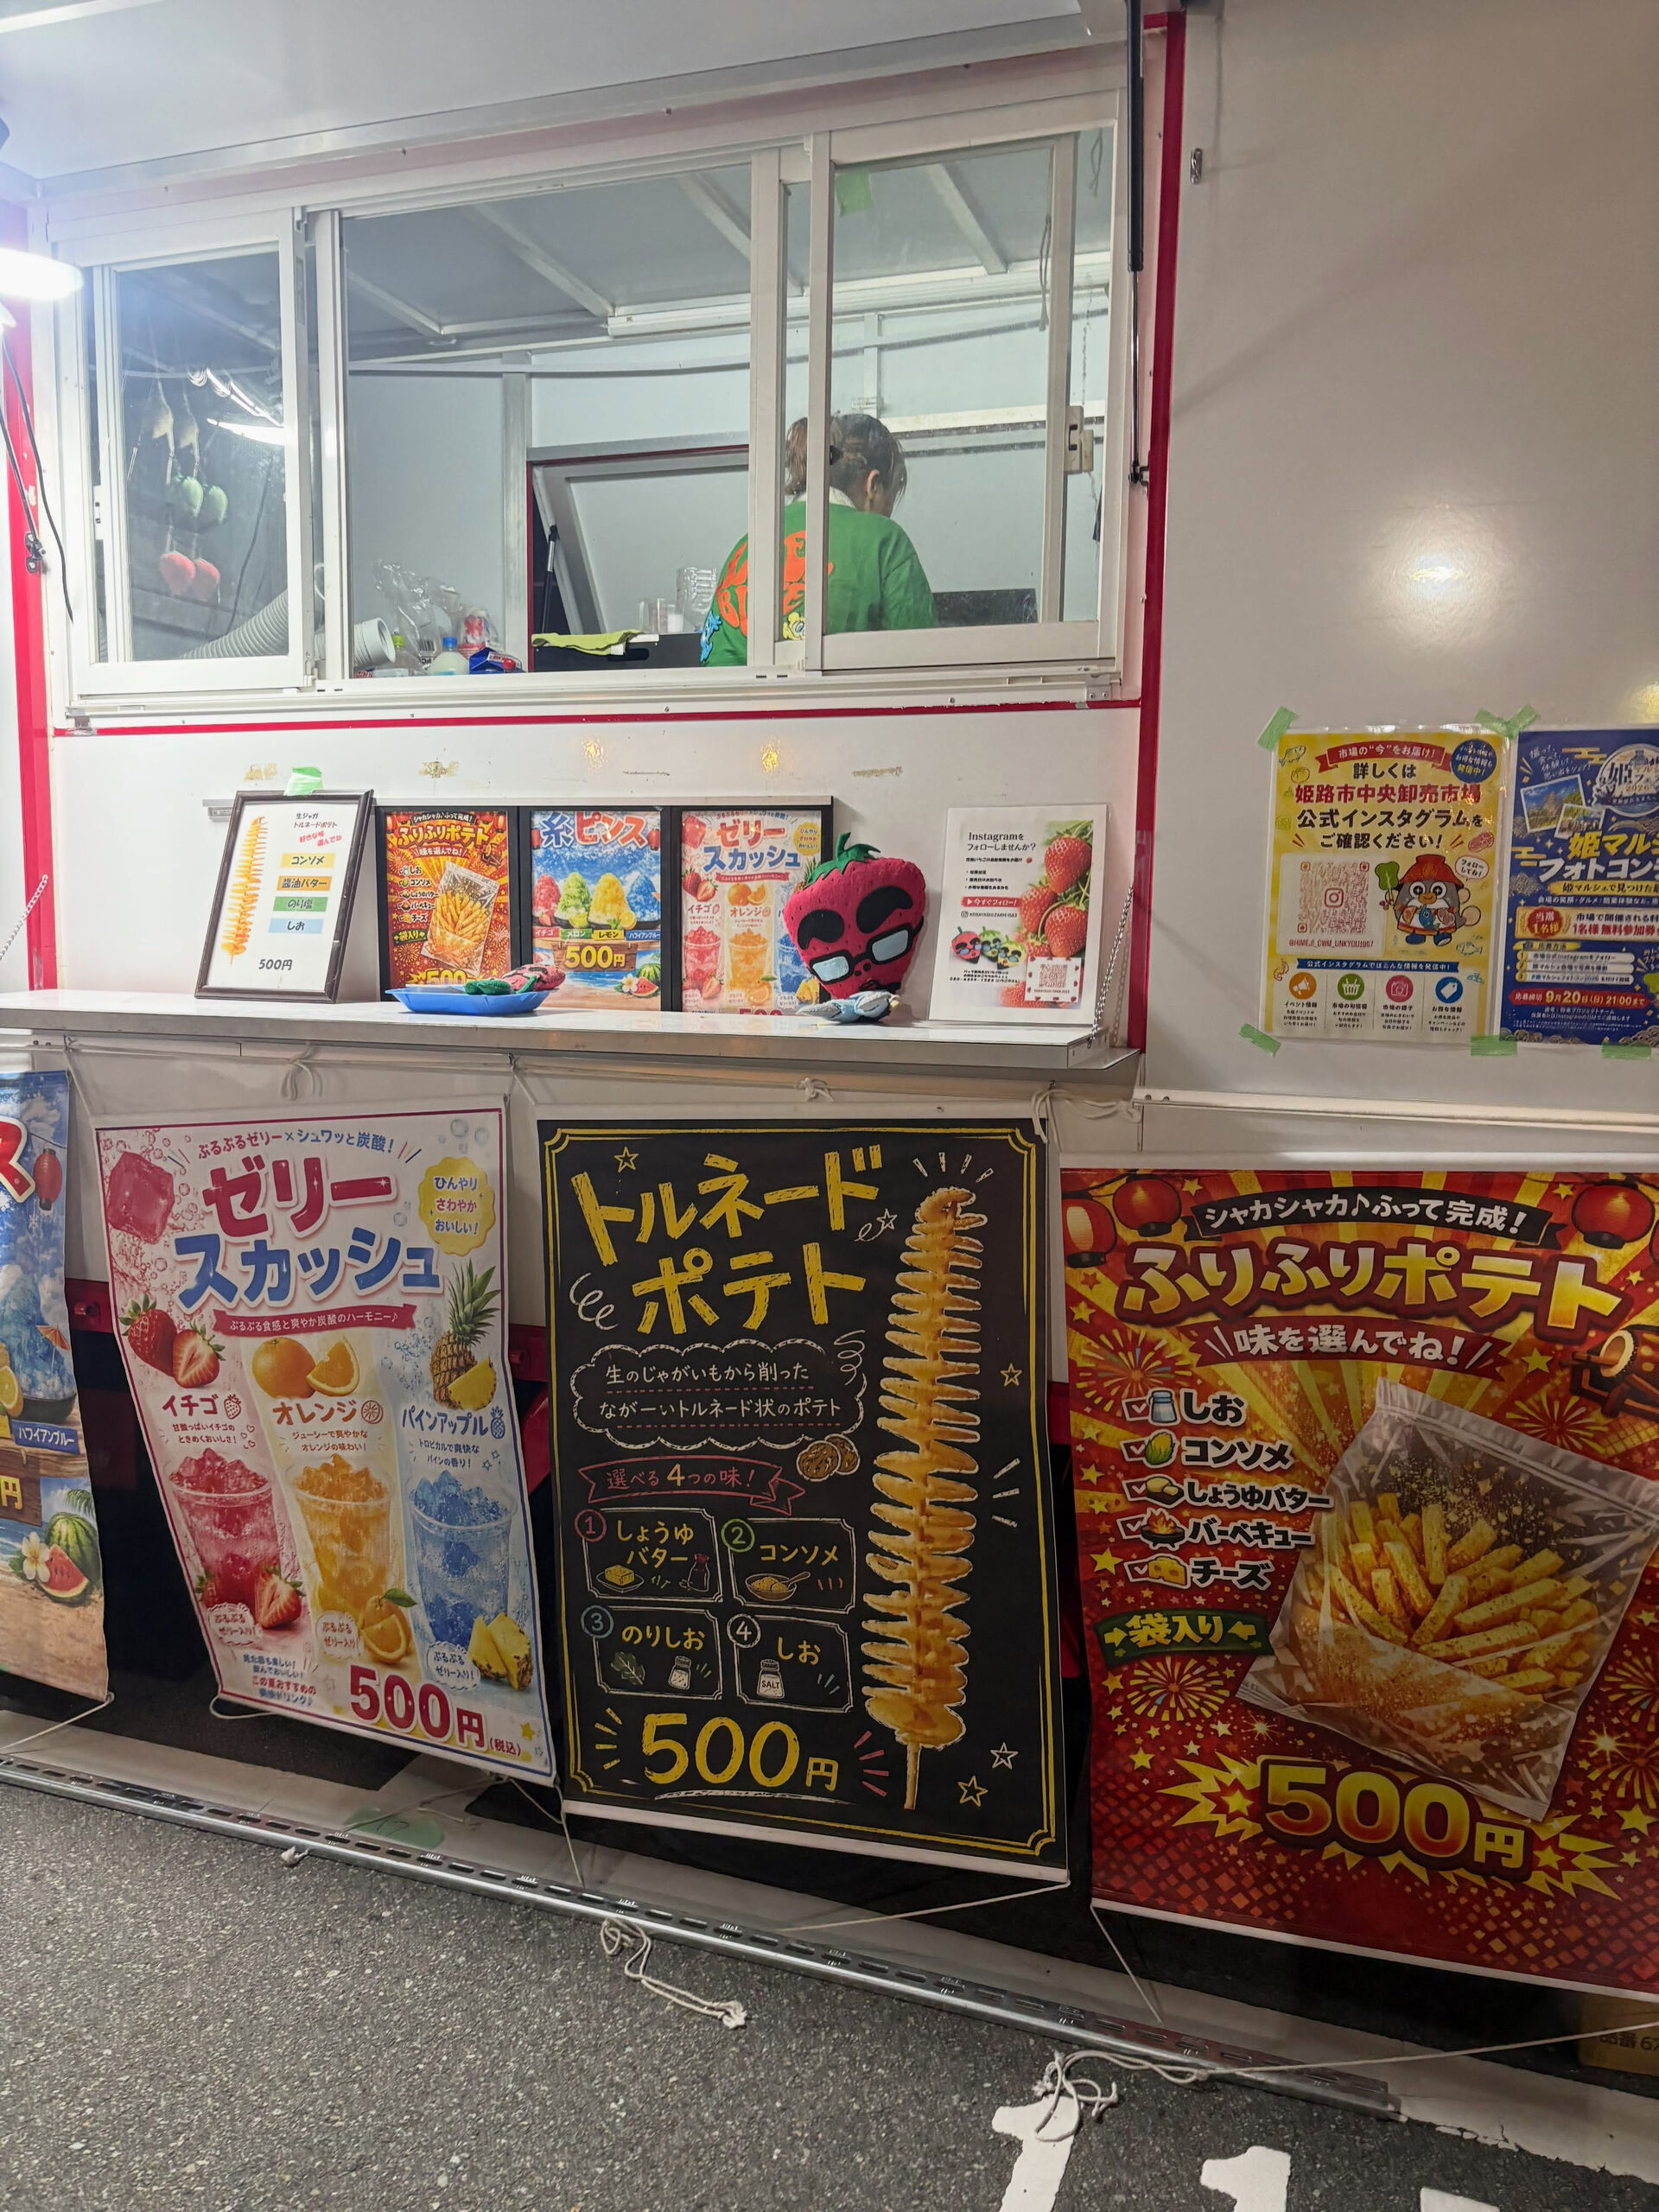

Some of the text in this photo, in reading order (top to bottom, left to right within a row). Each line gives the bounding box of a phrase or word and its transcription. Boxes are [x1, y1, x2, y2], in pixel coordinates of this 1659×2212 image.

[1352, 763, 1417, 779] 詳しくは
[1295, 784, 1481, 804] 姫路市中央卸売市場
[540, 810, 646, 847] 糸ピンス
[1297, 809, 1484, 828] 公式インスタグラムを
[397, 823, 489, 847] ふりふりポテト
[717, 819, 785, 848] ゼリー
[1320, 833, 1443, 849] ご確認ください!
[291, 856, 324, 865] コンソメ
[702, 845, 801, 872] スカッシュ
[282, 878, 327, 888] 醤油バター
[288, 899, 313, 909] のり塩
[688, 904, 710, 913] イチゴ
[730, 906, 762, 917] オレンジ
[287, 920, 305, 931] しお
[536, 928, 554, 937] イチゴ
[1573, 924, 1659, 937] 1名様無料参加券
[258, 959, 293, 970] 500円
[563, 945, 626, 968] 500円
[197, 1130, 395, 1159] ぷるぷるゼリー×シュワッと炭酸!
[203, 1154, 392, 1234] ゼリー
[434, 1176, 478, 1191] ひんやり
[435, 1198, 478, 1212] さわやか
[570, 1144, 881, 1267] トルネード
[435, 1218, 480, 1235] おいしい!
[175, 1227, 441, 1310] スカッシュ
[632, 1243, 866, 1334] ポテト
[1122, 1242, 1623, 1331] ふりふりポテト
[1234, 1324, 1462, 1365] 味を選んでね!
[605, 1364, 810, 1386] 生のじゃがいもから削った
[162, 1394, 219, 1417] イチゴ
[272, 1400, 357, 1426] オレンジ
[600, 1399, 841, 1420] ながーいトルネード状のポテト
[1181, 1391, 1246, 1424] しお
[173, 1423, 235, 1432] 甘酸っぱいイチゴの
[402, 1405, 489, 1436] パインアップル
[19, 1427, 74, 1446] ハワイアンブルー
[293, 1430, 368, 1440] ジューシーで爽やかな
[302, 1442, 366, 1452] オレンジの味わい!
[1180, 1437, 1293, 1469] コンソメ
[428, 1455, 471, 1468] パインの香り!
[607, 1463, 756, 1491] 選べる4つの味!
[1185, 1481, 1331, 1512] しょうゆバター
[617, 1520, 694, 1543] しょうゆ
[1186, 1518, 1314, 1550] バーベキュー
[626, 1548, 689, 1567] バター
[760, 1542, 839, 1567] コンソメ
[1190, 1559, 1272, 1588] チーズ
[621, 1624, 705, 1650] のりしお
[1128, 1613, 1224, 1646] 袋入り
[434, 1651, 465, 1666] ぷるぷる
[778, 1637, 821, 1665] しお
[435, 1666, 474, 1681] ゼリー入り!
[761, 1679, 781, 1690] SALT
[350, 1664, 522, 1757] 500円 (税込)
[642, 1713, 839, 1791] 500円
[1266, 1764, 1526, 1869] 500円
